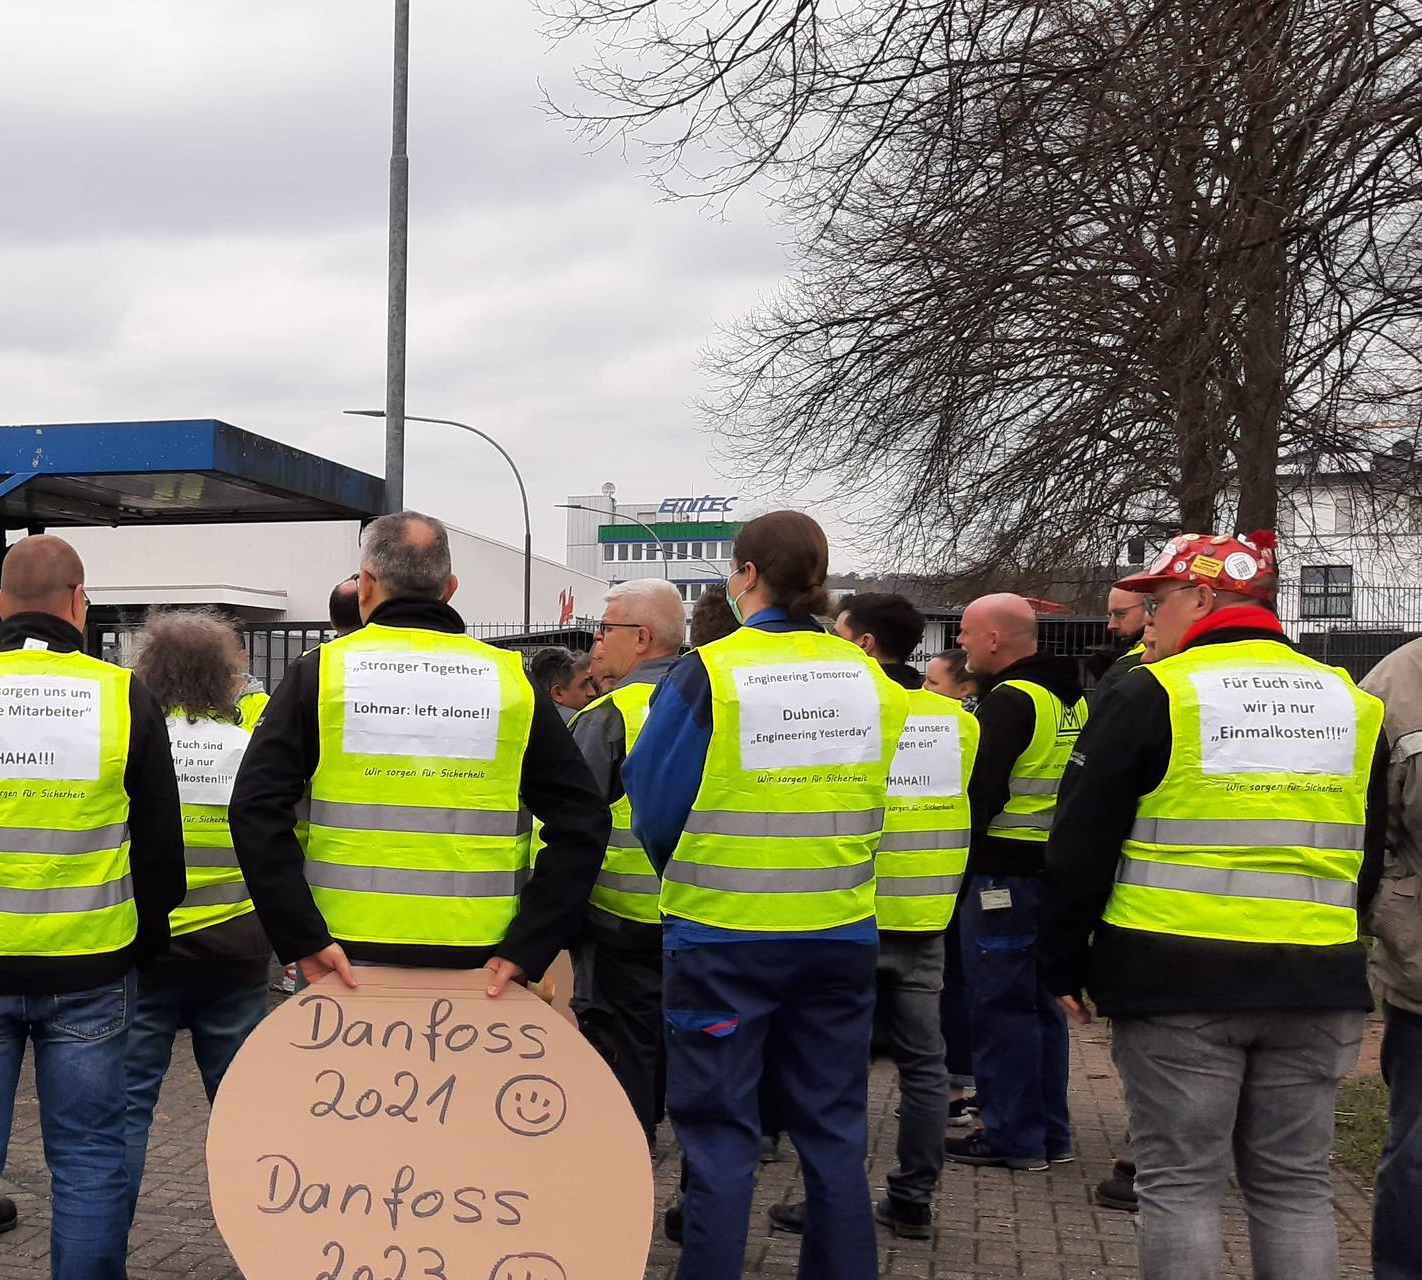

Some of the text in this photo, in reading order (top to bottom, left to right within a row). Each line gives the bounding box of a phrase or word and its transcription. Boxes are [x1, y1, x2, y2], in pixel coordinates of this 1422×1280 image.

[353, 661, 418, 673] „Stronger
[743, 671, 809, 686] „Engineering
[1222, 677, 1324, 690] Für Euch sind
[43, 688, 67, 698] uns
[70, 689, 92, 699] um
[354, 702, 490, 720] Lohmar: left alone!!
[1243, 700, 1315, 715] wir ja nur
[783, 707, 840, 721] Dubnica:
[750, 730, 817, 745] „Engineering
[176, 740, 200, 749] Euch
[202, 741, 223, 750] sind
[185, 757, 194, 767] ja
[365, 768, 486, 778] Wir sorgen für Sicherheit
[757, 773, 868, 784] Wir sorgen für Sicherheit
[889, 776, 930, 786] HAHA!!!
[22, 788, 39, 798] für
[41, 788, 86, 798] Sicherheit
[1226, 782, 1244, 792] Wir
[1249, 784, 1283, 793] sorgen
[1286, 782, 1301, 792] für
[289, 994, 548, 1062] Danfoss
[309, 1069, 457, 1125] 2021
[256, 1154, 530, 1231] Danfoss
